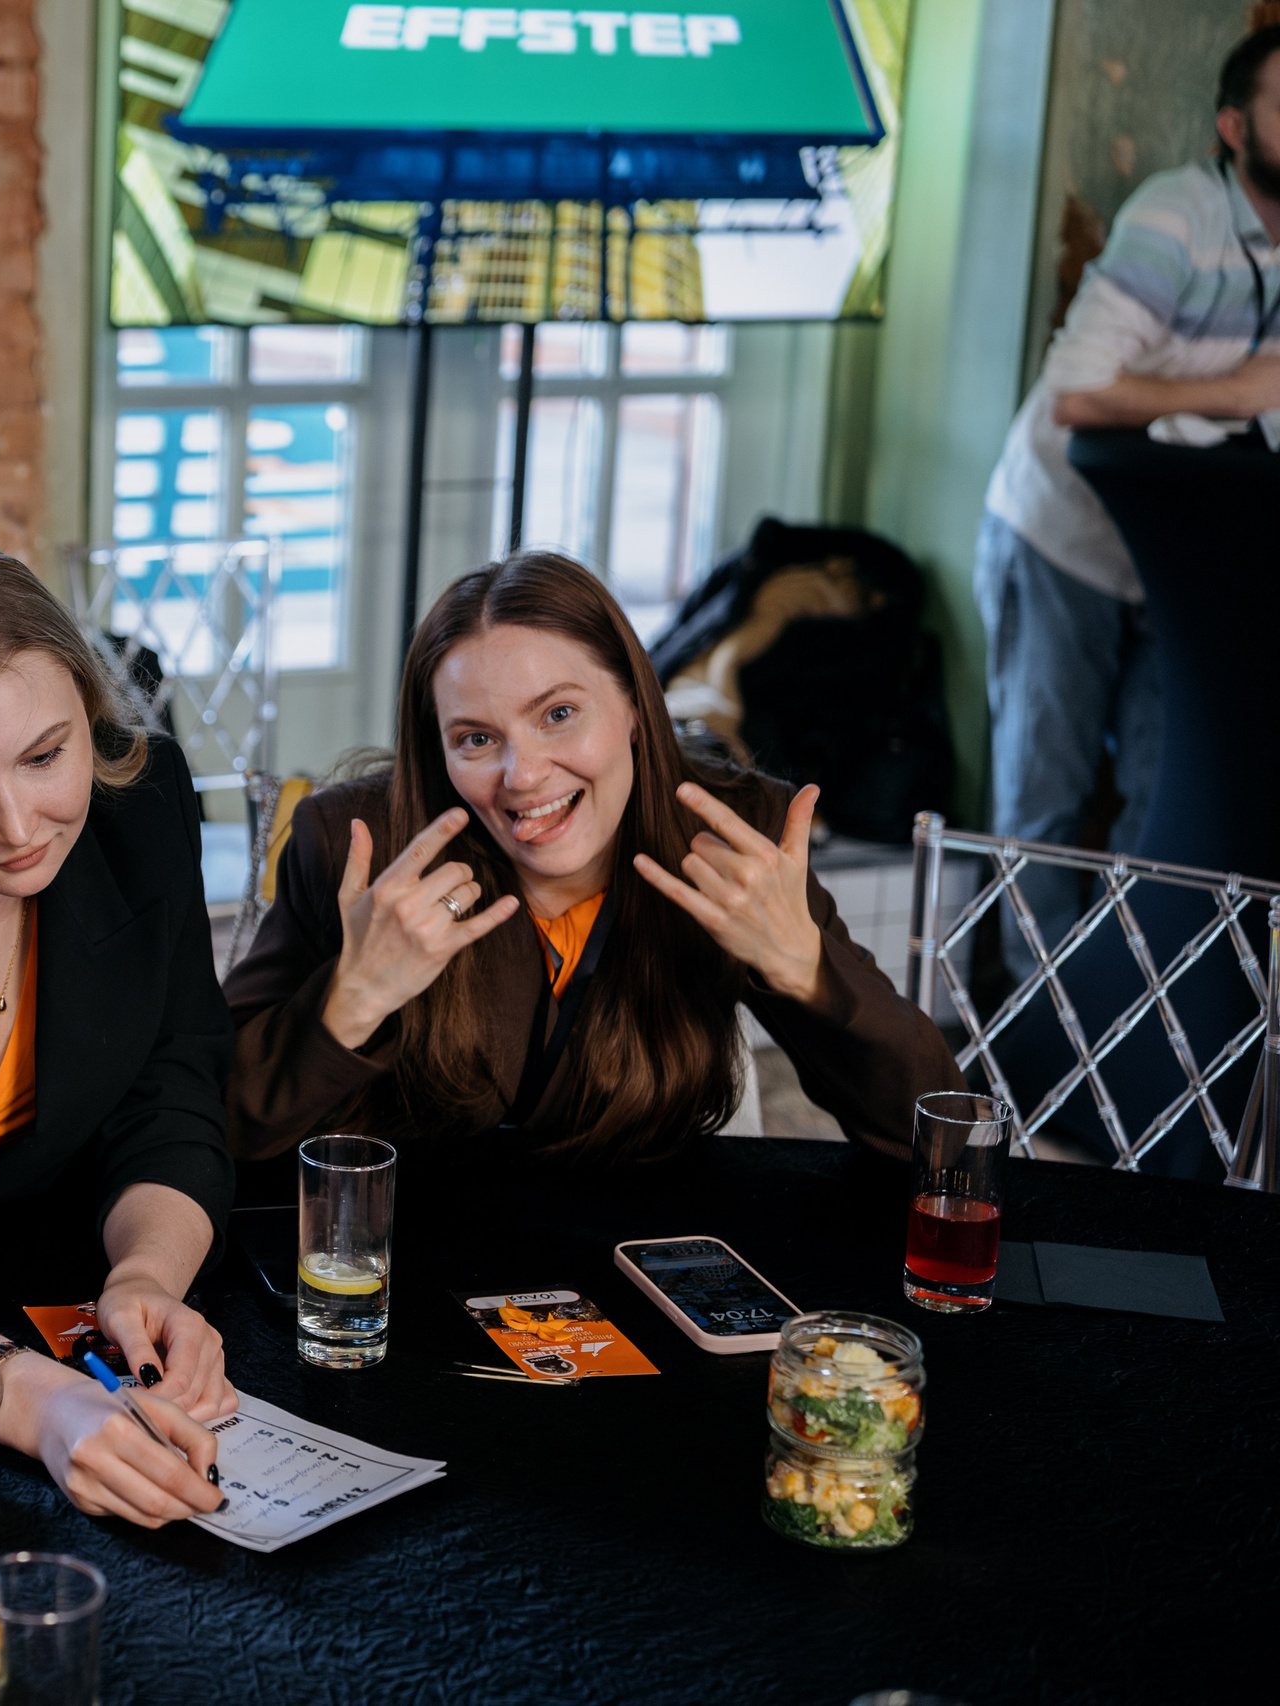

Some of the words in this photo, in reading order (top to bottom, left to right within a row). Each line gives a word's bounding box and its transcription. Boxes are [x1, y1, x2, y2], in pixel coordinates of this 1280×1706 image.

[338, 4, 742, 57] EFFSTEP
[709, 1308, 774, 1322] 17:04
[210, 1416, 243, 1435] КОМА
